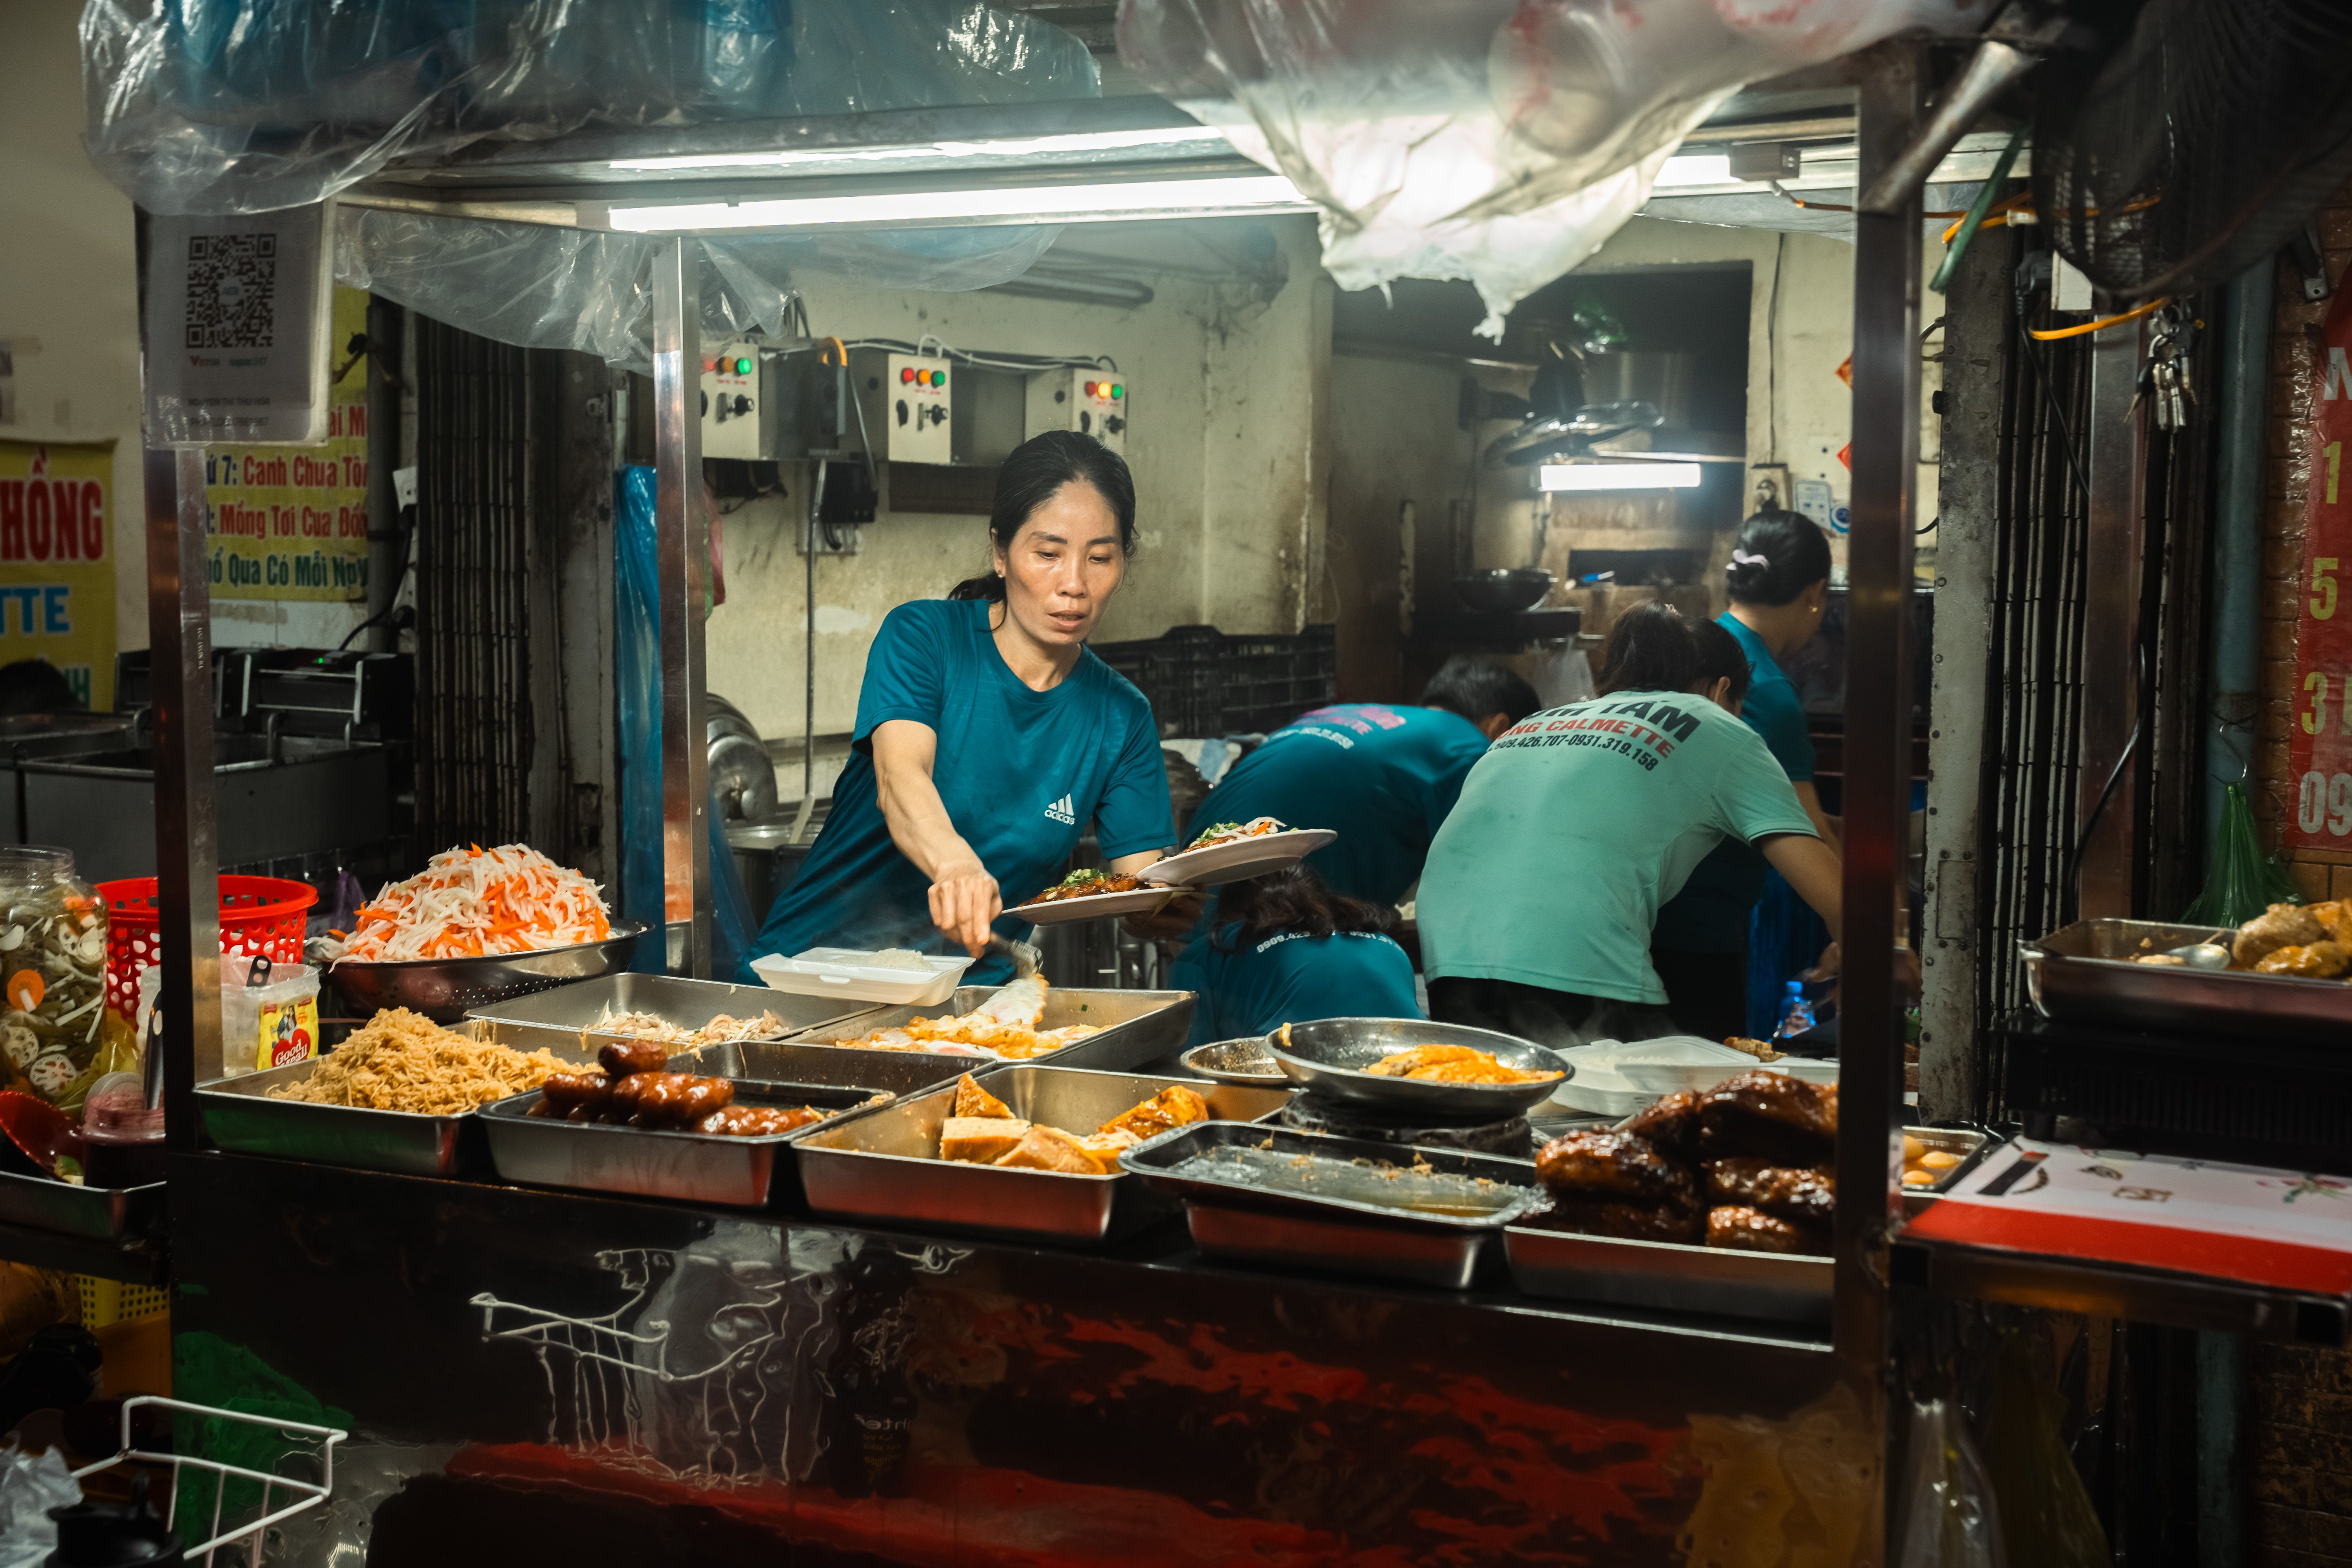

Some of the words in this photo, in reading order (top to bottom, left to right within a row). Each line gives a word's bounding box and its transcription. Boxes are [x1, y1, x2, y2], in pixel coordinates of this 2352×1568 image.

[222, 456, 237, 485] 7:
[243, 455, 287, 486] Canh
[293, 456, 338, 487] Chua
[2323, 441, 2342, 504] 1
[302, 506, 331, 537] Cua
[228, 554, 261, 587] Qua
[267, 555, 289, 586] Có
[2309, 557, 2338, 621] 5
[2301, 671, 2328, 735] 3
[1545, 719, 1675, 759] CALMETTE
[1044, 809, 1075, 825] adidas
[275, 1038, 301, 1066] Good
